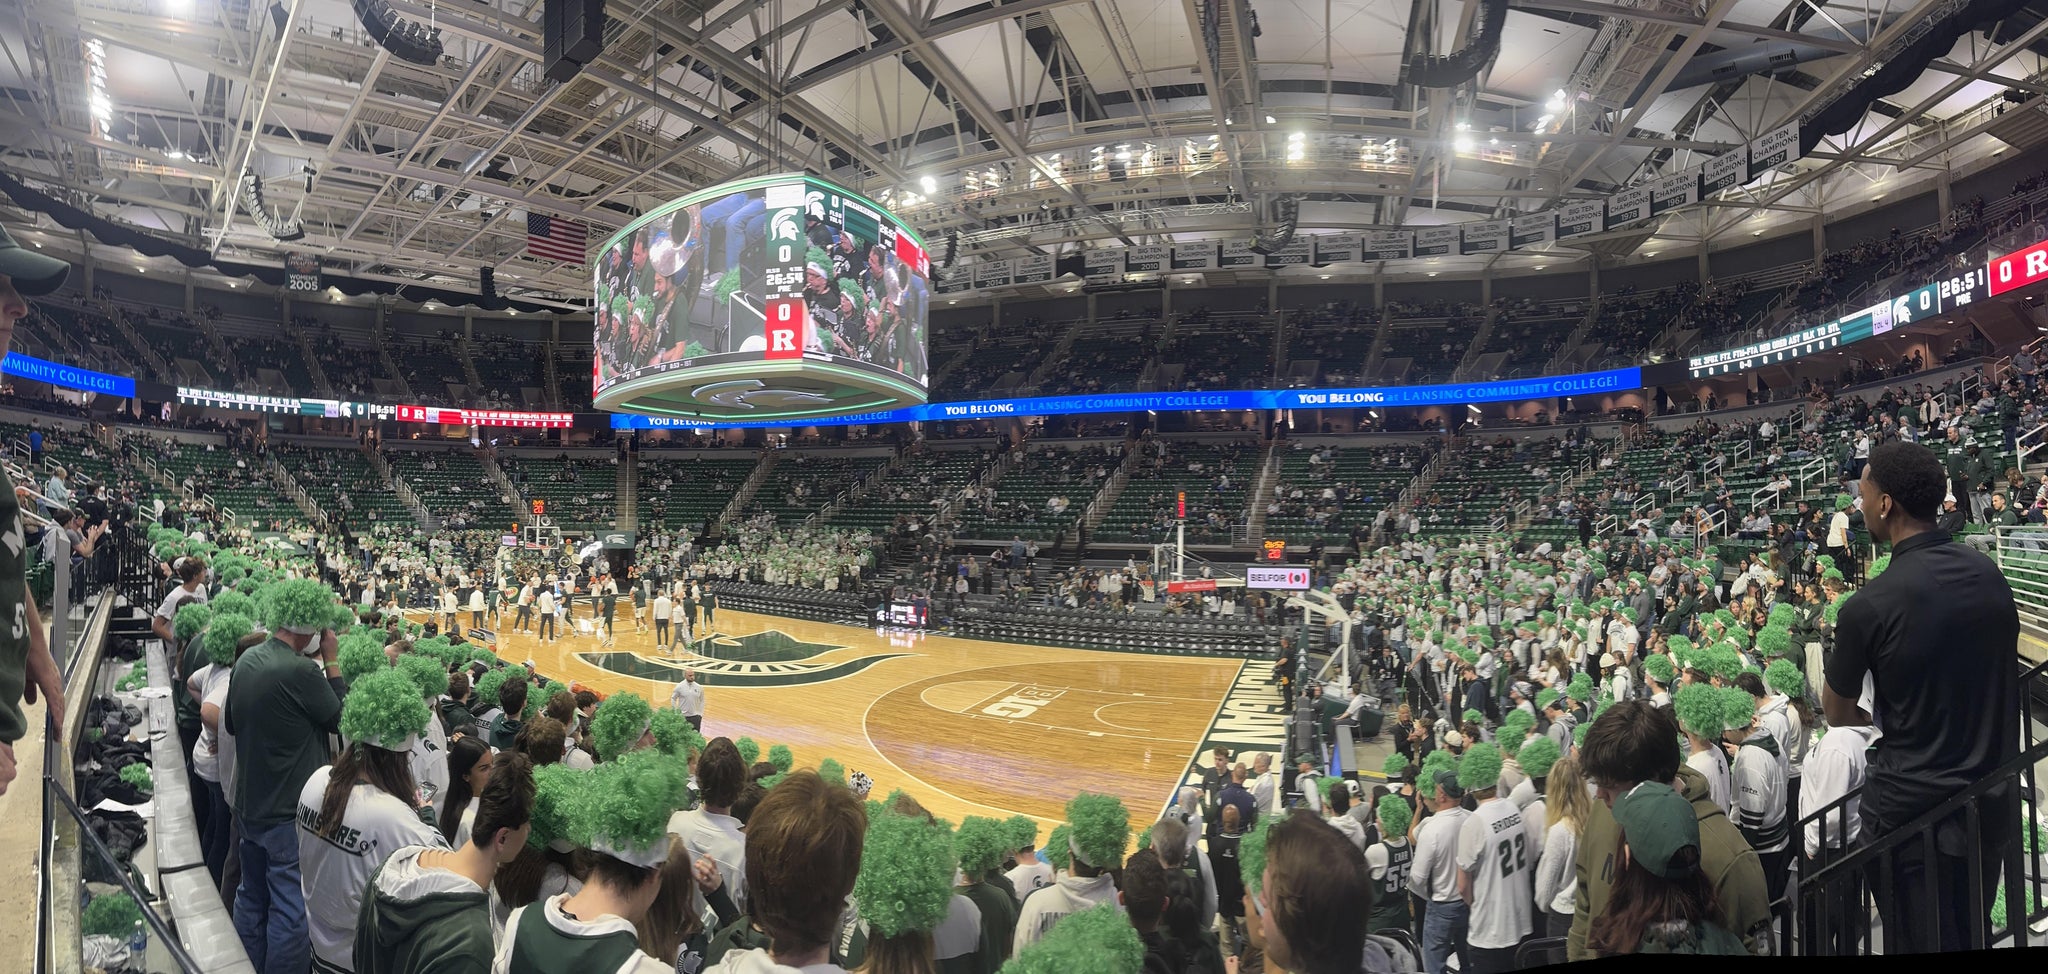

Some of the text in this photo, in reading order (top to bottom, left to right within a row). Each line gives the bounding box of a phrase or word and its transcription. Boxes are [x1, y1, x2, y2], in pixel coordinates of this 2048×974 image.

[1761, 129, 1789, 147] BIG TEN
[1754, 133, 1798, 160] CHAMPIONS
[1713, 153, 1739, 170] BIG TEN
[1766, 152, 1785, 166] 1957
[1706, 158, 1746, 181] CHAMPIONS
[1662, 175, 1689, 189] BIG TEN
[1717, 175, 1734, 188] 1959
[1655, 180, 1697, 199] CHAMPIONS
[831, 195, 839, 208] 0
[1617, 191, 1641, 203] BIG TEN
[1667, 196, 1685, 207] 1967
[1610, 196, 1649, 213] CHAMPIONS
[1561, 211, 1602, 224] CHAMPIONS
[1621, 210, 1638, 220] 1978
[1572, 223, 1590, 233] 1979
[1418, 236, 1459, 245] CHAMPIONS
[1466, 231, 1508, 240] CHAMPIONS
[1320, 242, 1360, 250] CHAMPIONS
[778, 245, 791, 262] 0
[1130, 253, 1170, 261] CHAMPIONS
[1177, 249, 1217, 258] CHAMPIONS
[1279, 255, 1303, 264] 2000
[1087, 256, 1124, 265] CHAMPIONS
[1140, 262, 1159, 270] 2010
[2000, 250, 2048, 283] 0 R
[766, 272, 804, 286] 26:54
[980, 272, 1011, 280] CHAMPIONS
[290, 280, 318, 291] 2005
[986, 279, 1004, 288] 2014
[1919, 268, 1983, 311] 0 26:51
[1955, 292, 1972, 307] PRE
[778, 303, 791, 321] 0
[1874, 319, 1888, 330] TOL 4
[1788, 335, 1801, 345] AST
[1803, 330, 1815, 341] BLK
[1817, 327, 1826, 336] TO
[1828, 322, 1840, 333] STL
[772, 329, 796, 352] R
[1693, 336, 1837, 378] 0 0 0 0-0 0 0 0 0 0 0
[2, 356, 116, 391] MMUNITY COLLEGE!
[1298, 375, 1618, 404] YOU BELONG at LANSING COMMUNITY COLLEGE!
[945, 406, 967, 415] YOU
[970, 403, 1014, 414] BELONG
[1030, 400, 1082, 411] LANSING
[1085, 397, 1162, 409] COMMUNITY
[1165, 395, 1229, 406] COLLEGE!
[357, 404, 364, 415] 0
[401, 408, 408, 417] 0
[413, 409, 424, 420] R
[843, 411, 893, 421] COLLEGE!
[648, 417, 670, 426] YOU
[1250, 573, 1287, 582] BELFOR
[1394, 851, 1408, 862] CARR
[1498, 832, 1526, 879] 22
[1385, 861, 1411, 893] 55
